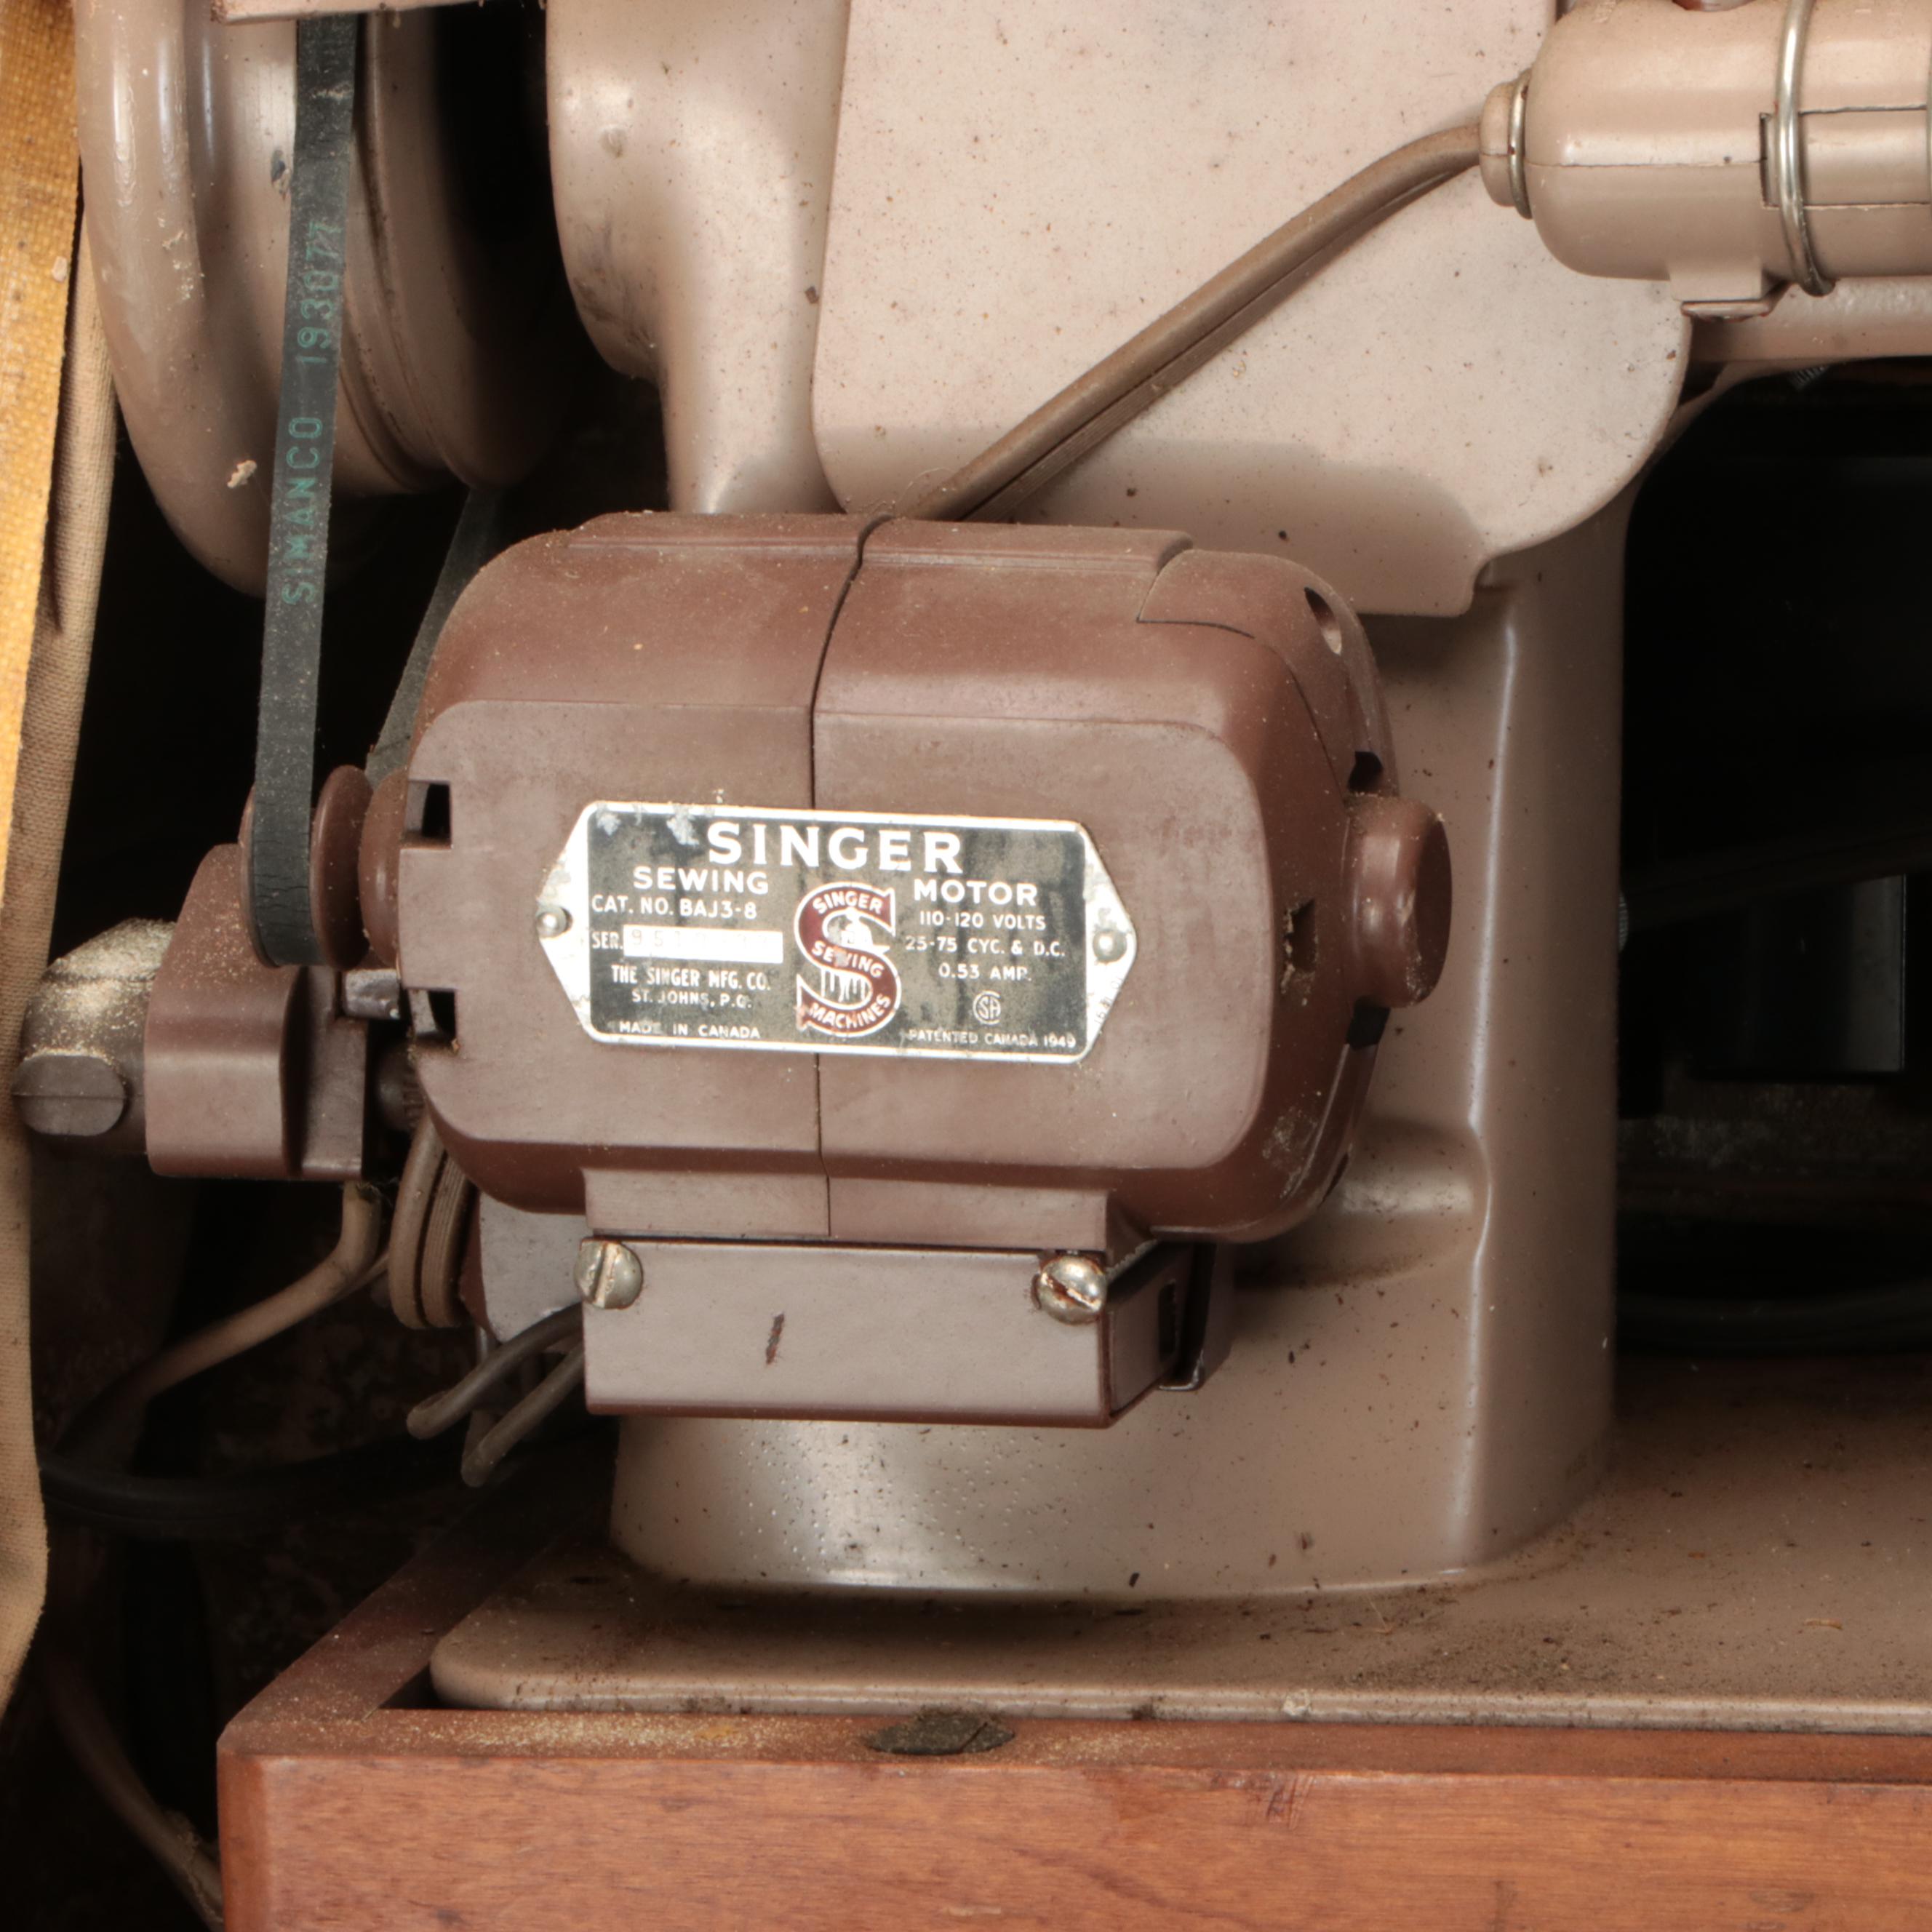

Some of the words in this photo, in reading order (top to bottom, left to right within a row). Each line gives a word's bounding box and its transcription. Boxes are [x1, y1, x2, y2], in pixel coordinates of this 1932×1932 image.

[296, 217, 343, 365] 193077
[281, 416, 323, 605] SIMANCO
[707, 821, 963, 874] SINGER
[634, 865, 768, 895] SEWING
[914, 878, 1038, 906] MOTOR
[591, 895, 634, 914] CAT.
[640, 897, 674, 916] NO.
[679, 898, 757, 920] BAJ3-8
[813, 890, 883, 914] SINGER
[919, 910, 983, 929] 110-120
[992, 914, 1046, 931] VOLTS
[592, 931, 623, 950] SER.
[906, 935, 958, 953] 25-75
[967, 938, 1005, 955] CYC.
[1010, 939, 1023, 956] &
[1034, 941, 1066, 958] D.C.
[611, 964, 639, 984] THE
[646, 966, 700, 988] SINGER
[708, 969, 743, 990] MFG.
[746, 971, 772, 991] CO.
[938, 962, 980, 980] 0.53
[631, 988, 653, 1003] ST.
[808, 994, 892, 1029] MACHINES
[672, 1023, 688, 1037] IN
[698, 1023, 761, 1039] CANADA
[909, 1029, 978, 1045] PATENTED
[983, 1031, 1038, 1047] CANADA
